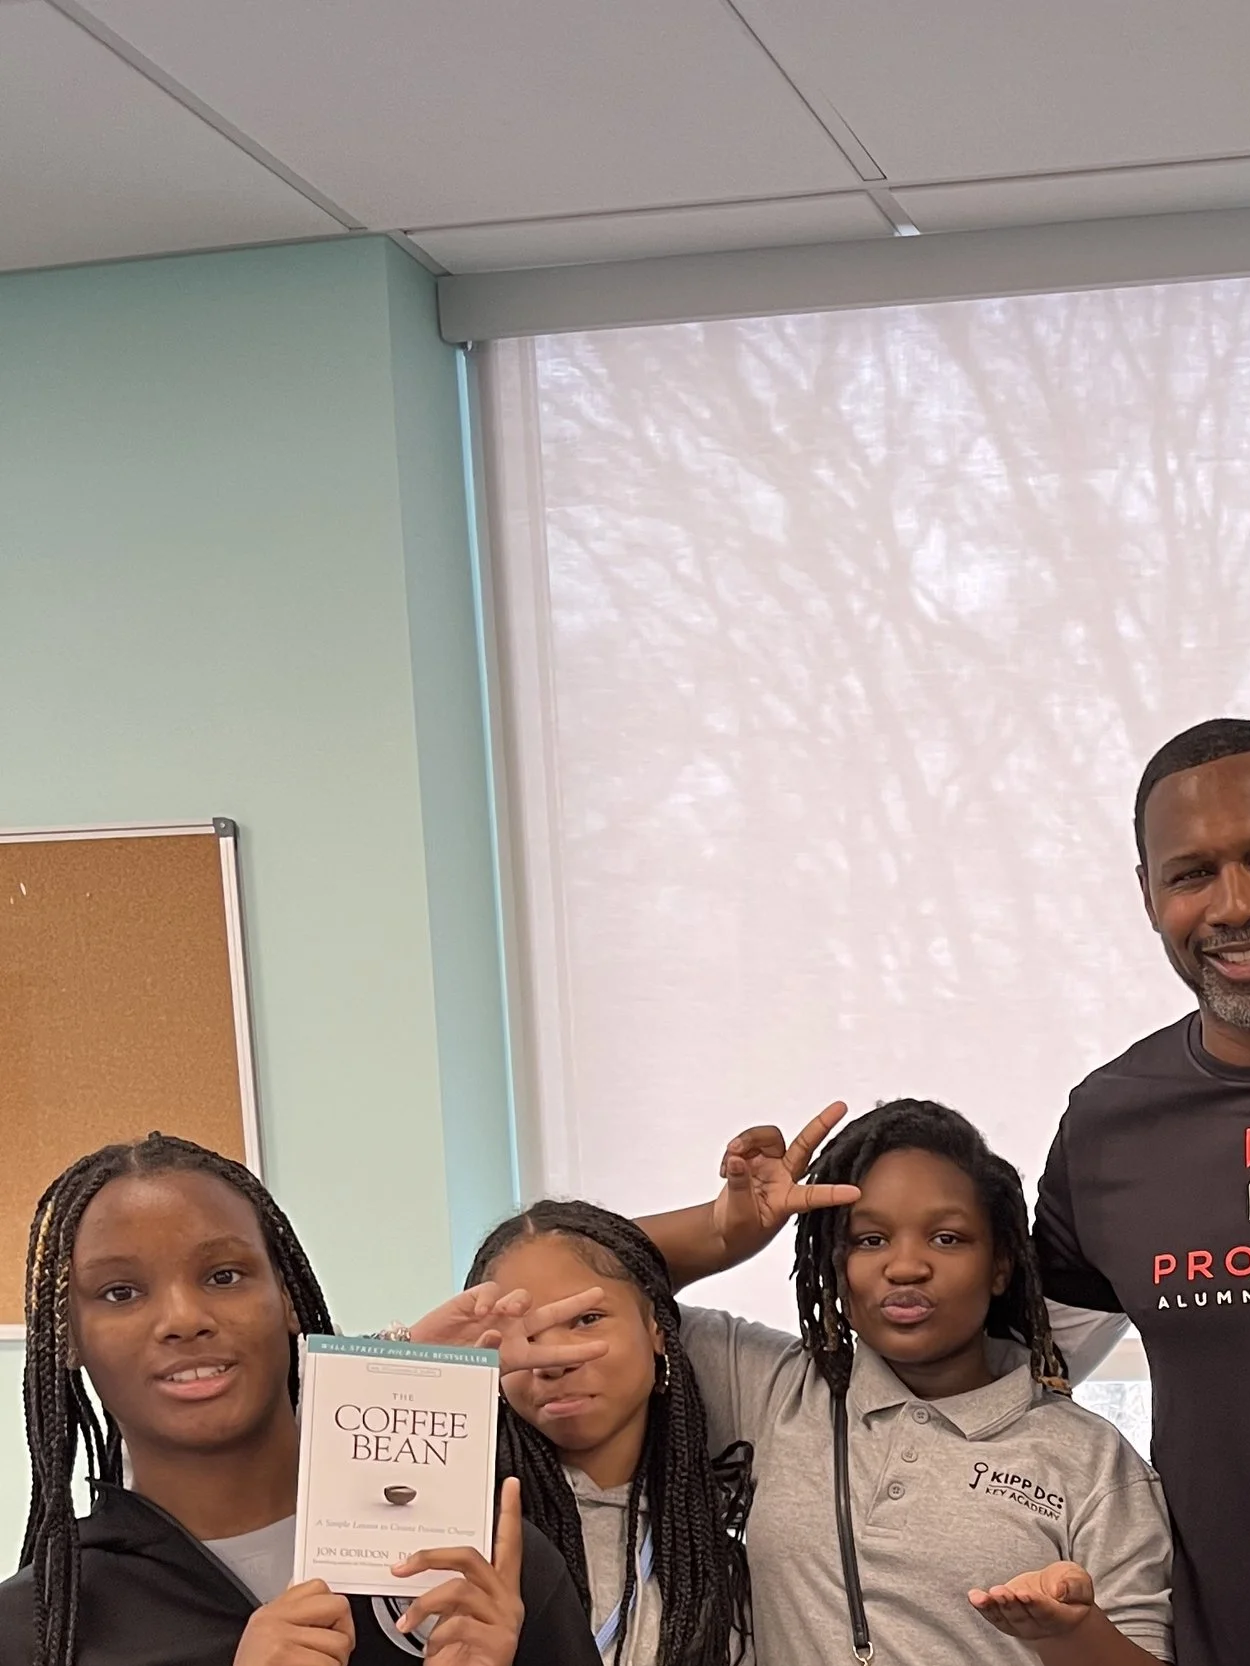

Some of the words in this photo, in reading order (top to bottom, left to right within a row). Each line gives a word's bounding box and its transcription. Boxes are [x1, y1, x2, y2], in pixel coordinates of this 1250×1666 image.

[432, 1352, 488, 1364] BESTSELLER
[392, 1393, 414, 1401] THE
[335, 1404, 468, 1439] COFFEE
[352, 1434, 448, 1465] BEAN
[991, 1471, 1032, 1489] KIPP
[985, 1487, 1007, 1496] KEY
[1009, 1492, 1060, 1520] ACADEMY
[316, 1547, 337, 1557] JON
[340, 1548, 389, 1560] GORDON
